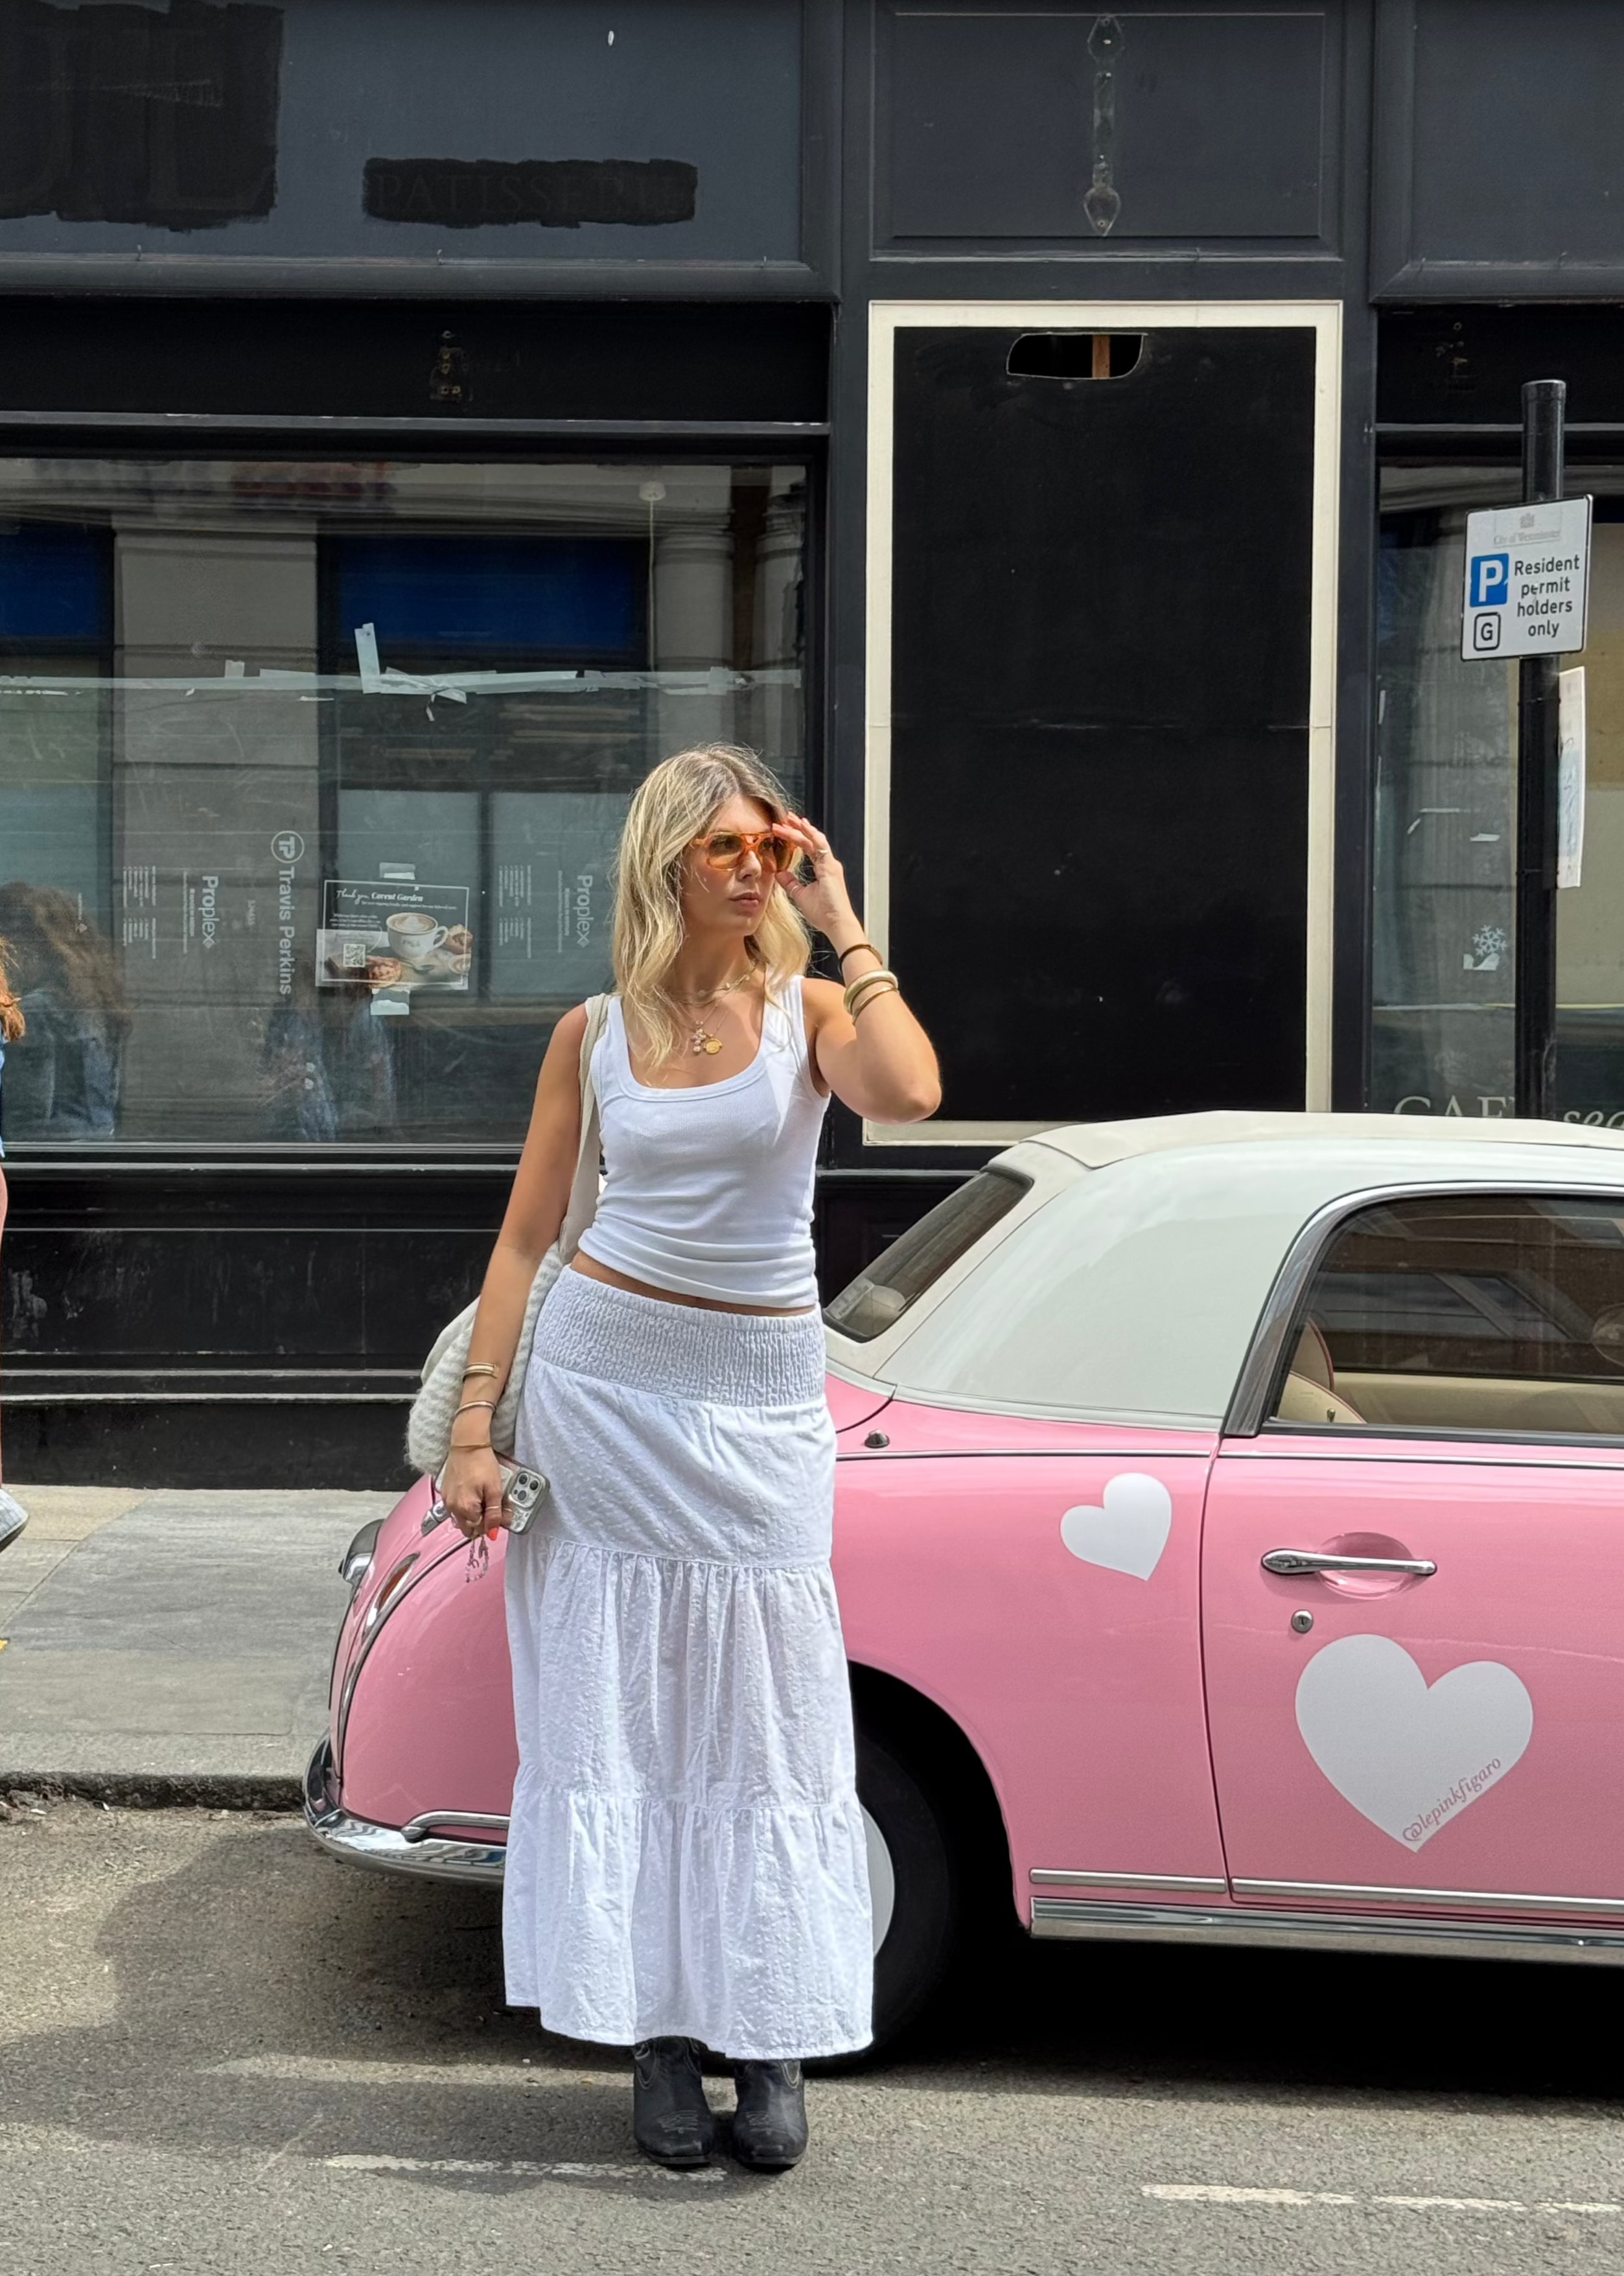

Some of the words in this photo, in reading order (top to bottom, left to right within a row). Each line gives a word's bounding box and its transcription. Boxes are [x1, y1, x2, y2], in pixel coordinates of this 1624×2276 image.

[1478, 559, 1503, 602] P
[1514, 555, 1580, 575] Resident
[1517, 599, 1573, 617] holders
[1522, 576, 1570, 599] permit
[1480, 622, 1493, 641] G
[1527, 619, 1559, 638] only
[198, 876, 220, 949] Proplex
[279, 866, 295, 921] Travis
[573, 875, 594, 948] Proplex
[279, 926, 296, 995] Perkins
[1402, 1758, 1501, 1842] @lepinkfigaro
